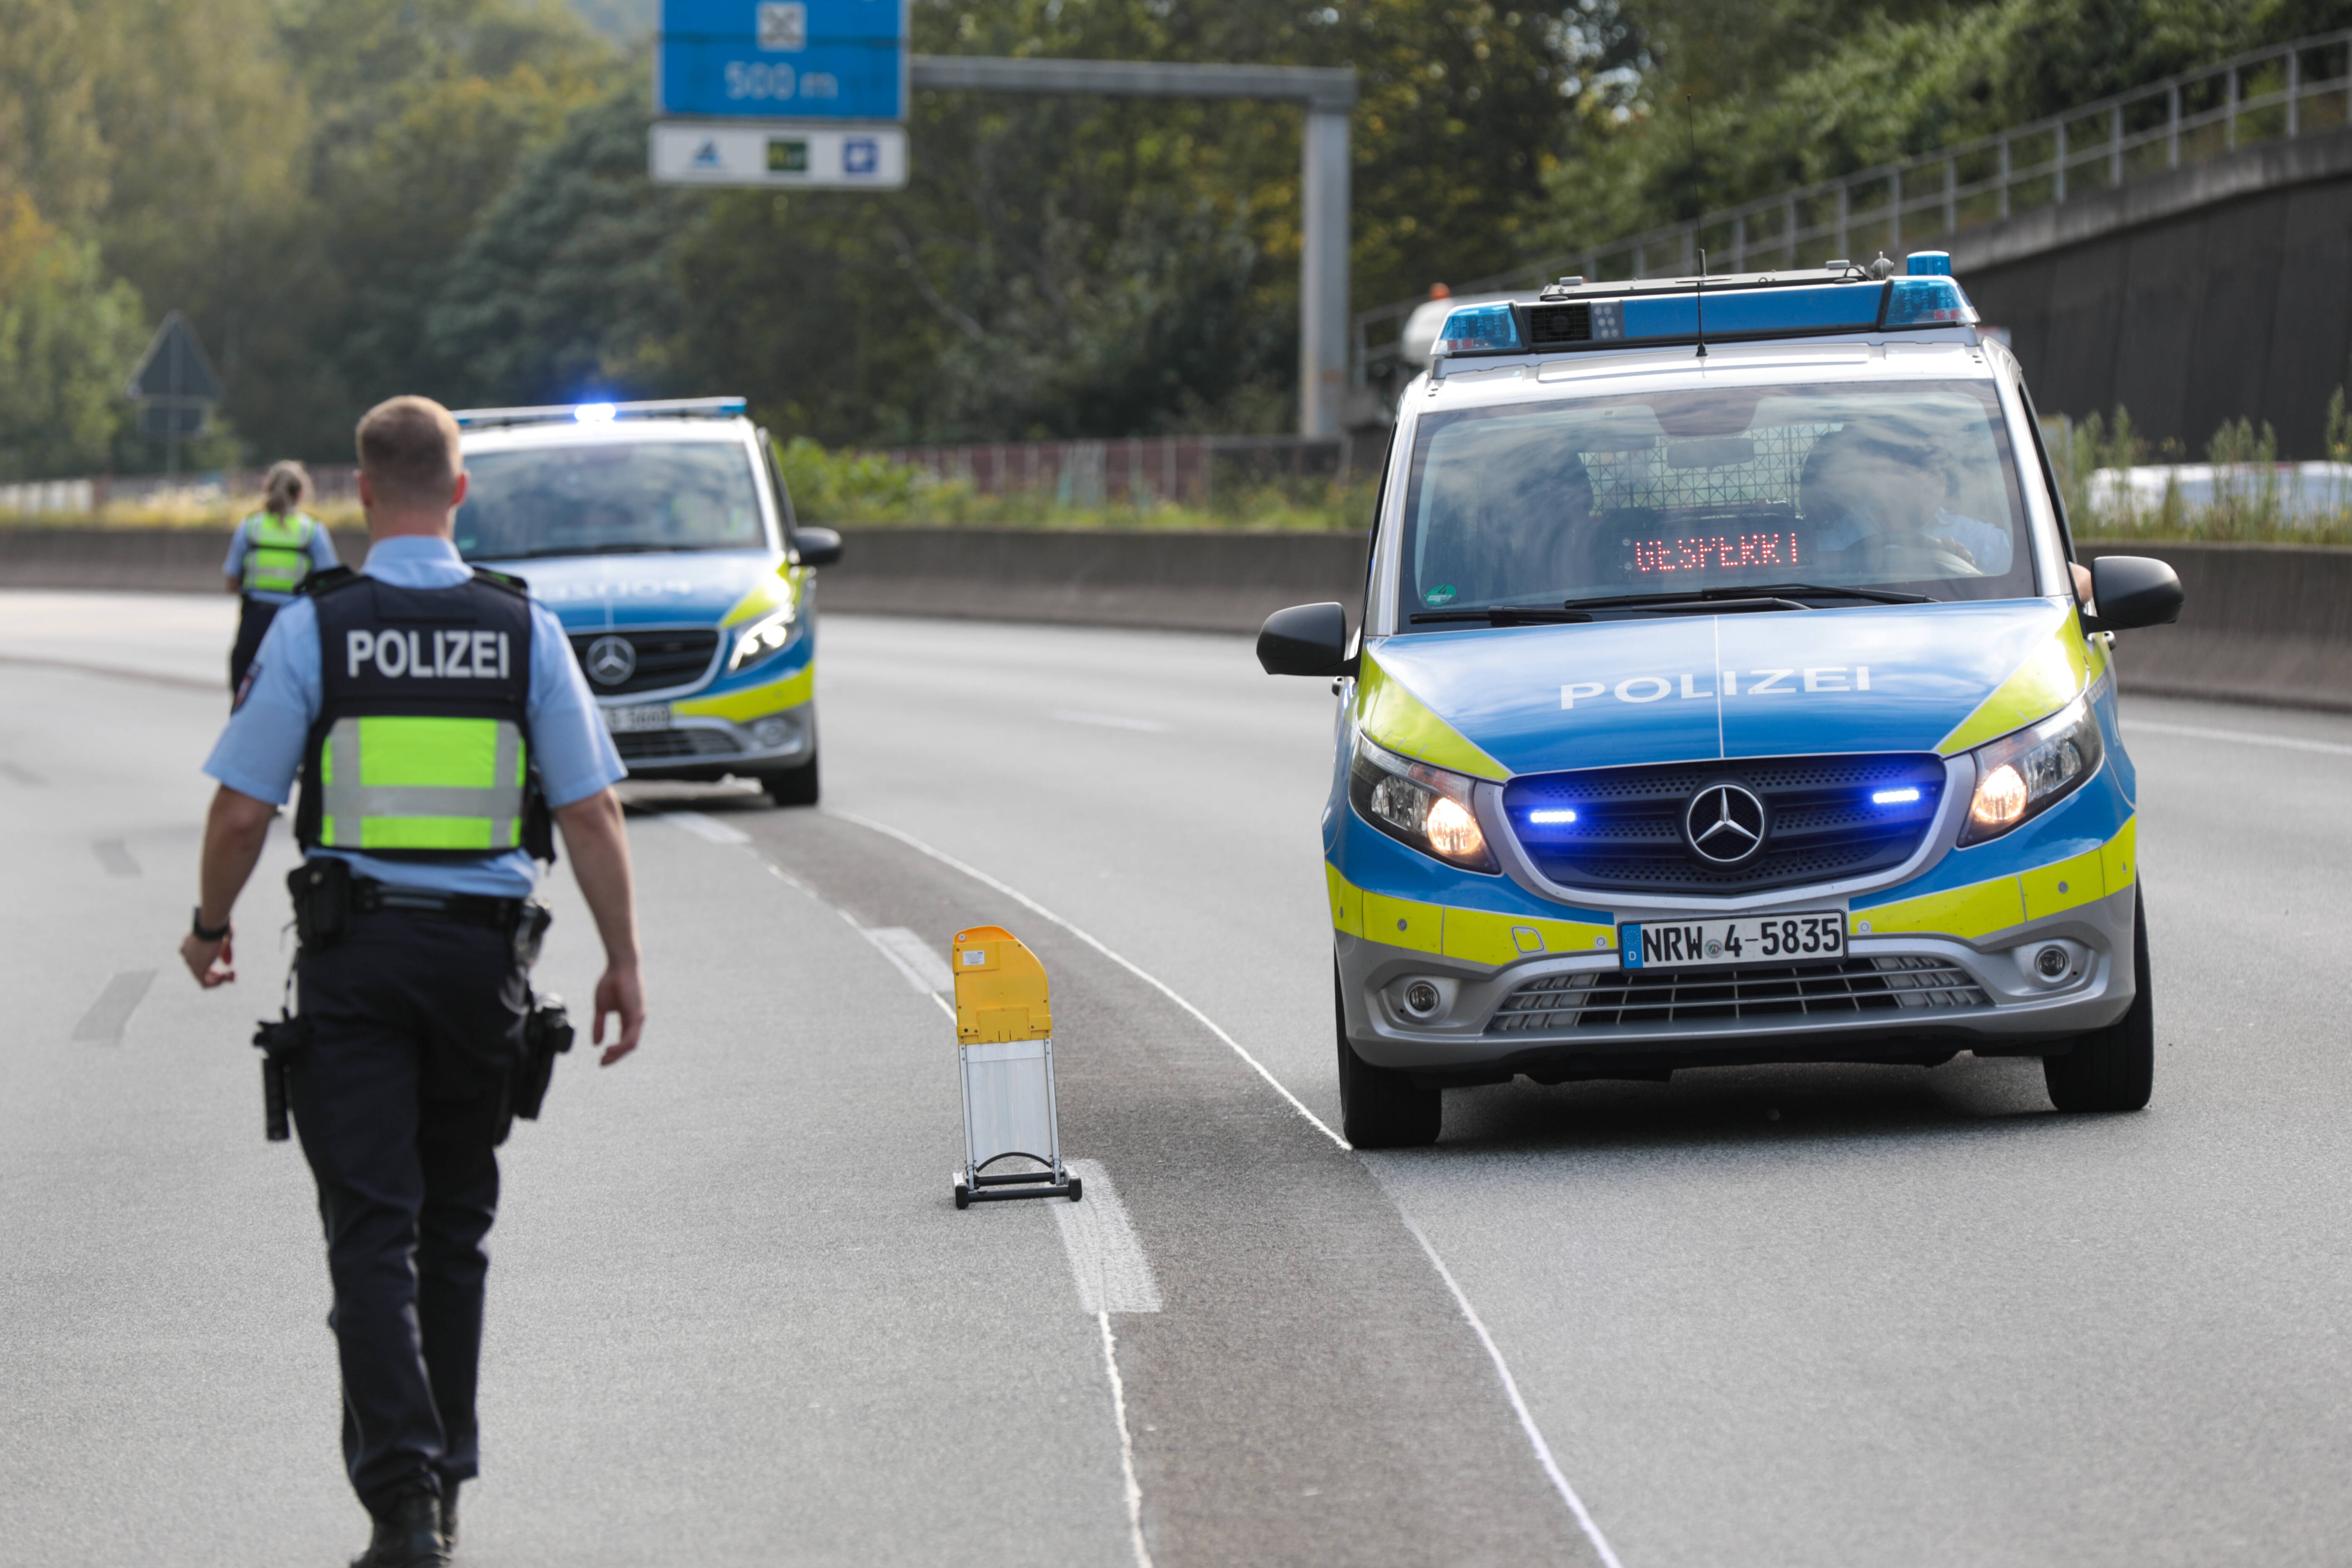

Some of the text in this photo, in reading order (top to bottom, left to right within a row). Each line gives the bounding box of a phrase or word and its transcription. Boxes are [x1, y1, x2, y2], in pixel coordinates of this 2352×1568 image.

[346, 630, 509, 678] POLIZEI
[1561, 666, 1871, 710] POLIZEI
[1629, 951, 1637, 961] D
[1642, 918, 1841, 962] NRW 4-5835
